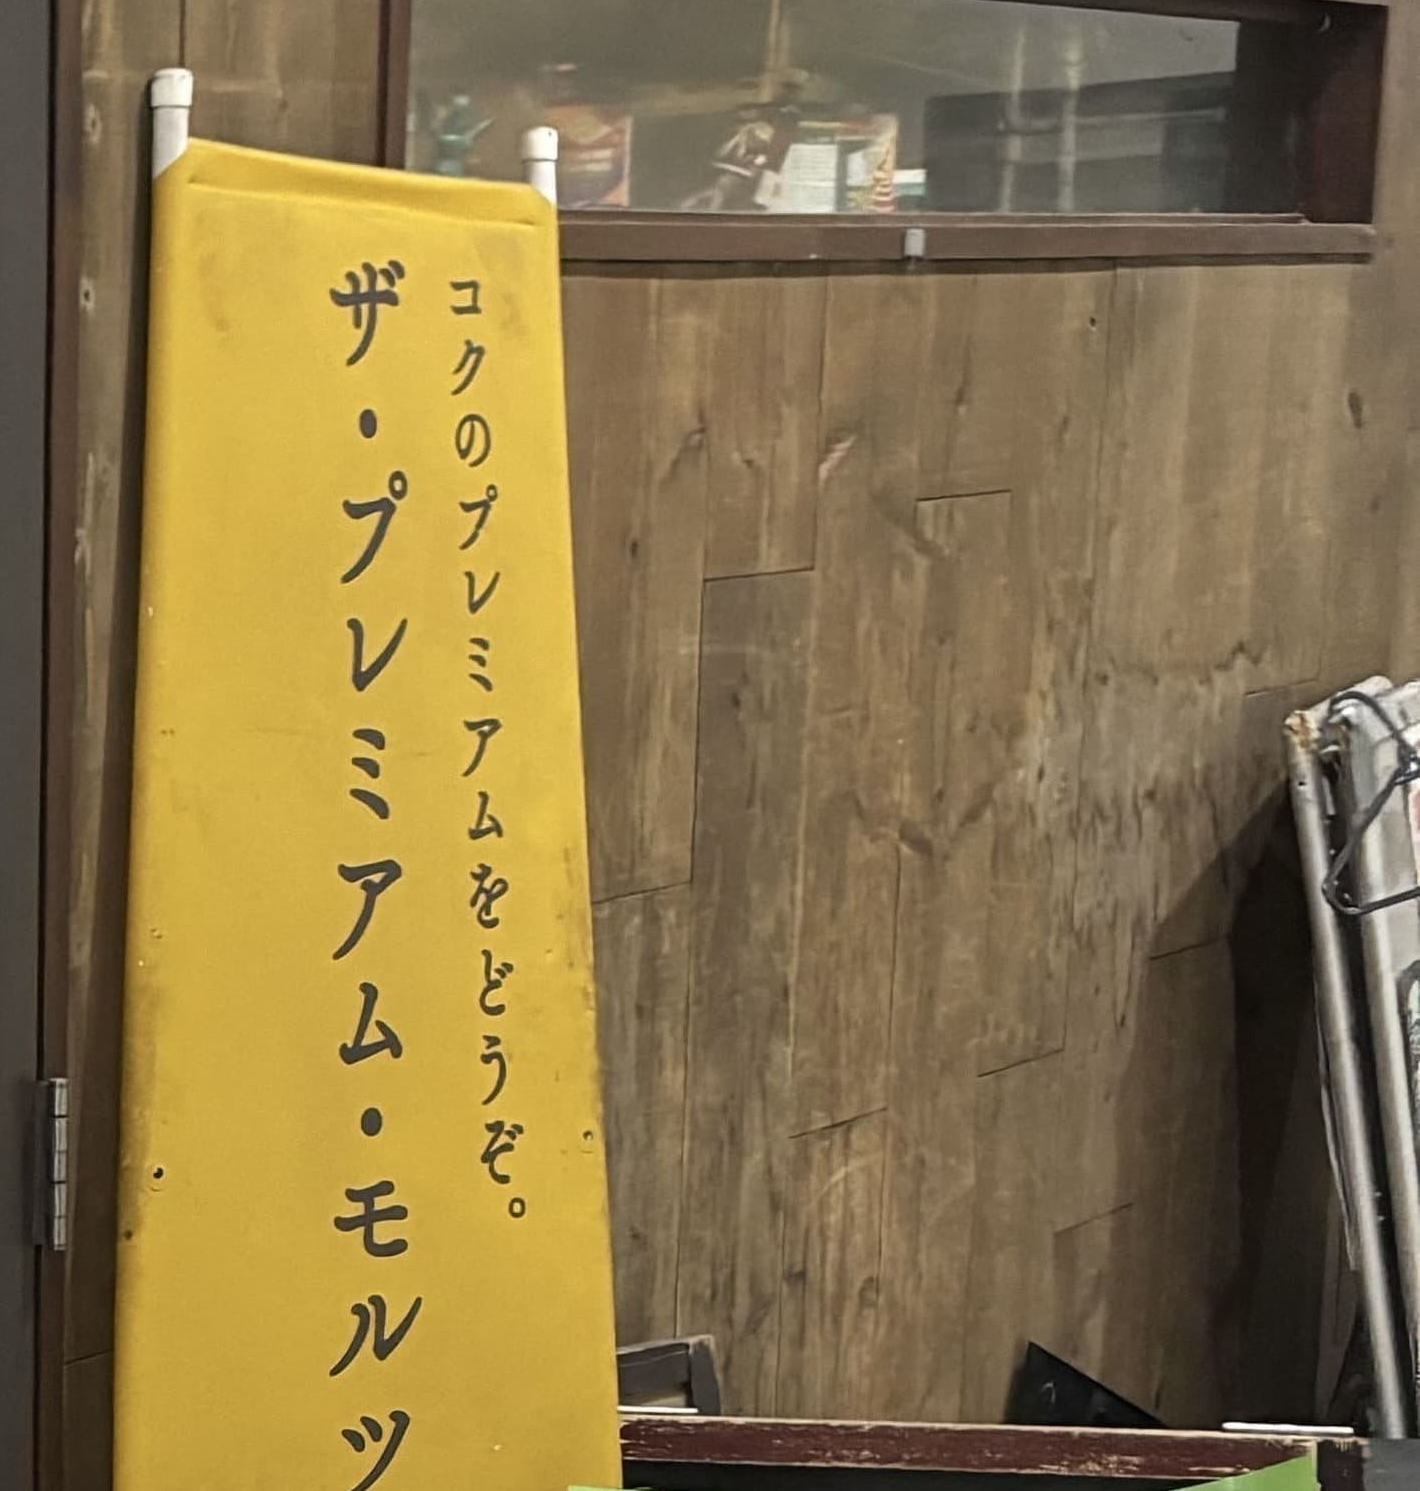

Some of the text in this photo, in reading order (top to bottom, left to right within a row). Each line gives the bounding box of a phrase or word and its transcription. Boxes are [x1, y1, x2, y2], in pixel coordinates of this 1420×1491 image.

[328, 259, 422, 1491] ザ・プレミアム・モルツ
[450, 279, 526, 1219] コクのプレミアムをどうぞ。
